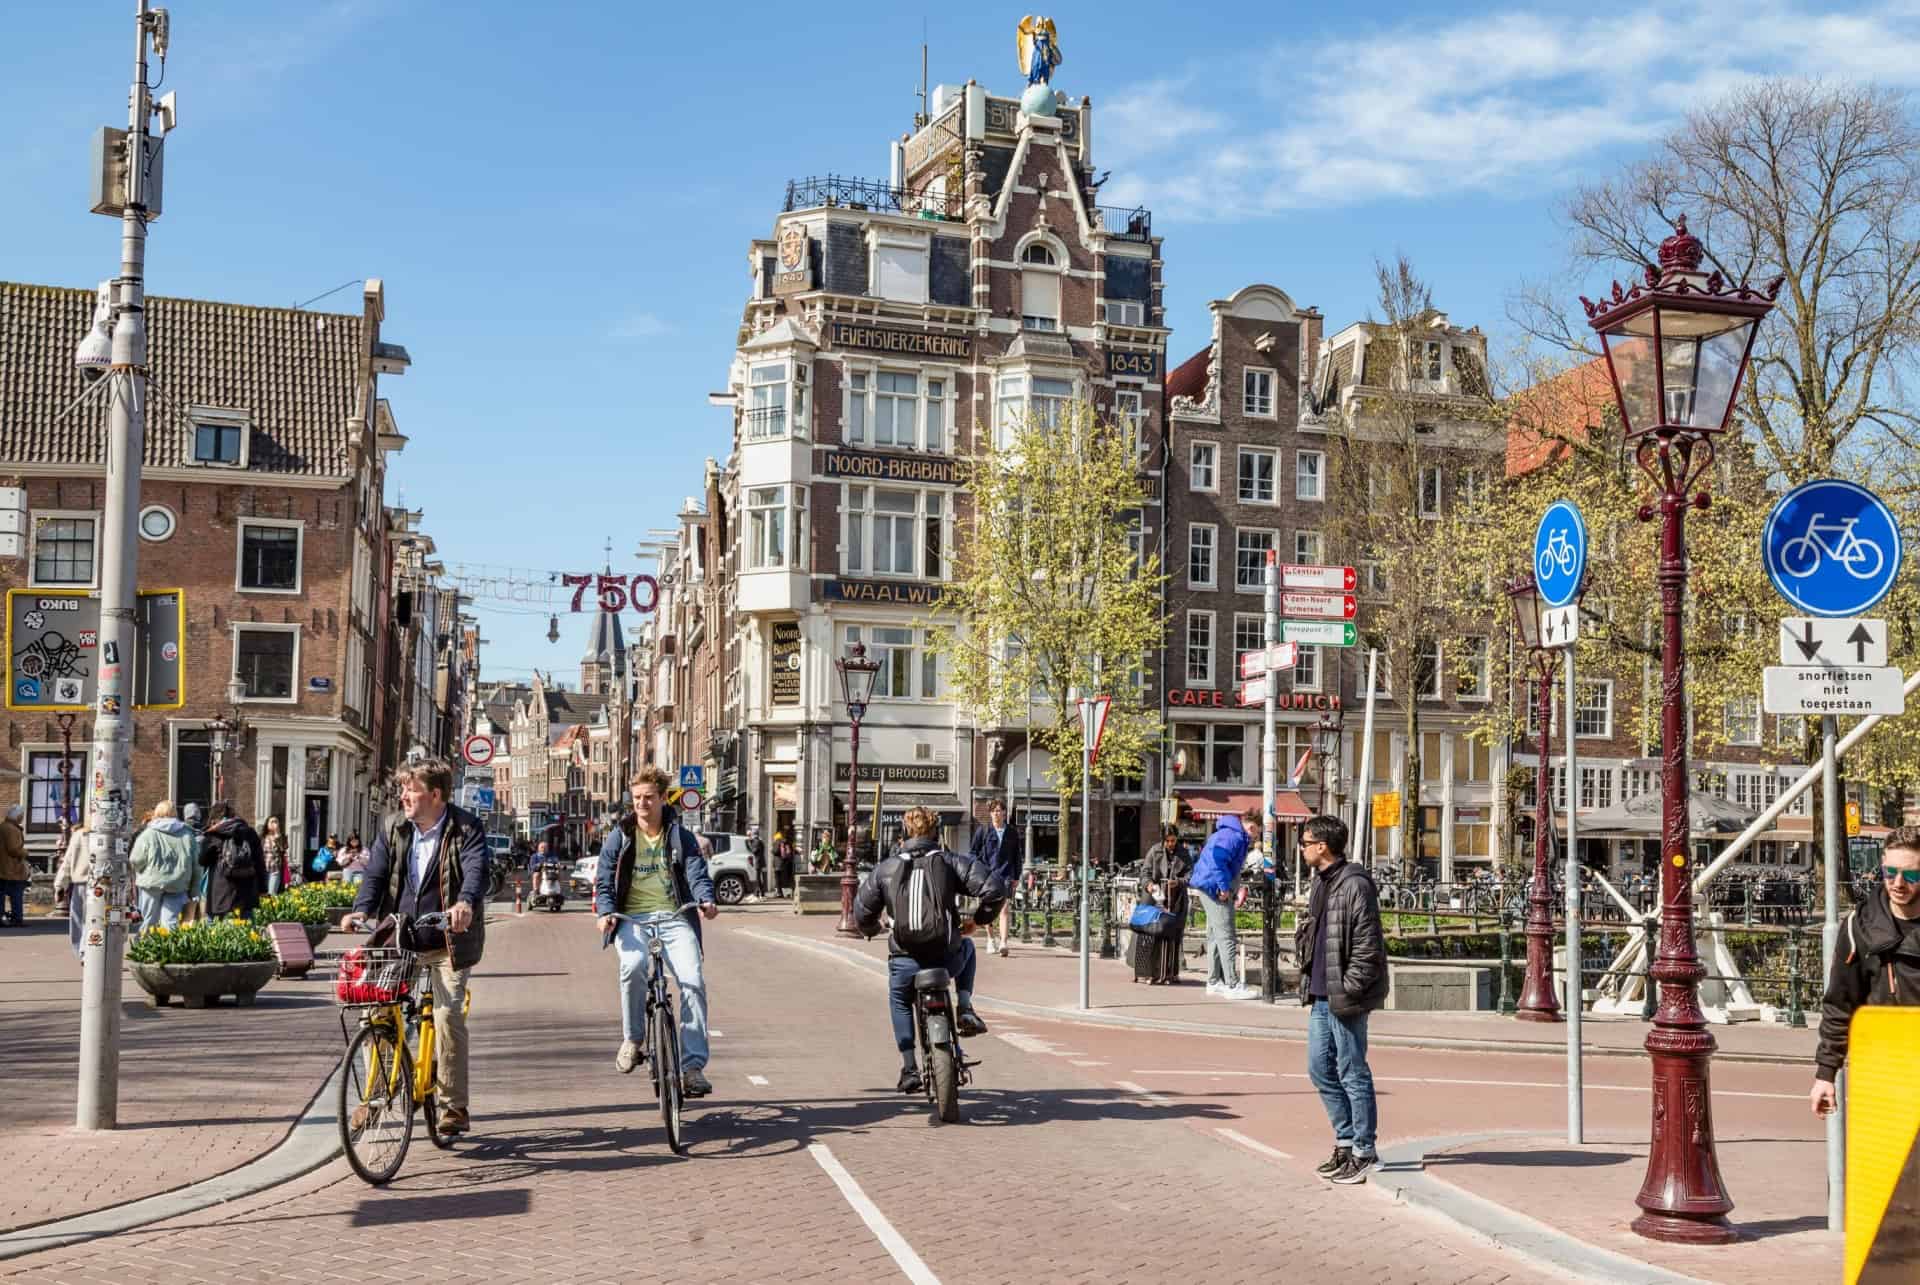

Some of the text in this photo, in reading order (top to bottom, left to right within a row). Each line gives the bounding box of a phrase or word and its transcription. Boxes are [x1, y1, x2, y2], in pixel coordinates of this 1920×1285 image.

[831, 326, 970, 357] LEVENSVERZEKERING
[1111, 353, 1152, 373] 1843
[562, 573, 660, 614] 750
[40, 599, 78, 611] BUKO
[1798, 671, 1872, 681] snorfietsen
[1823, 685, 1849, 694] niet
[1800, 699, 1872, 711] toegestaan
[888, 768, 945, 779] BROODJES
